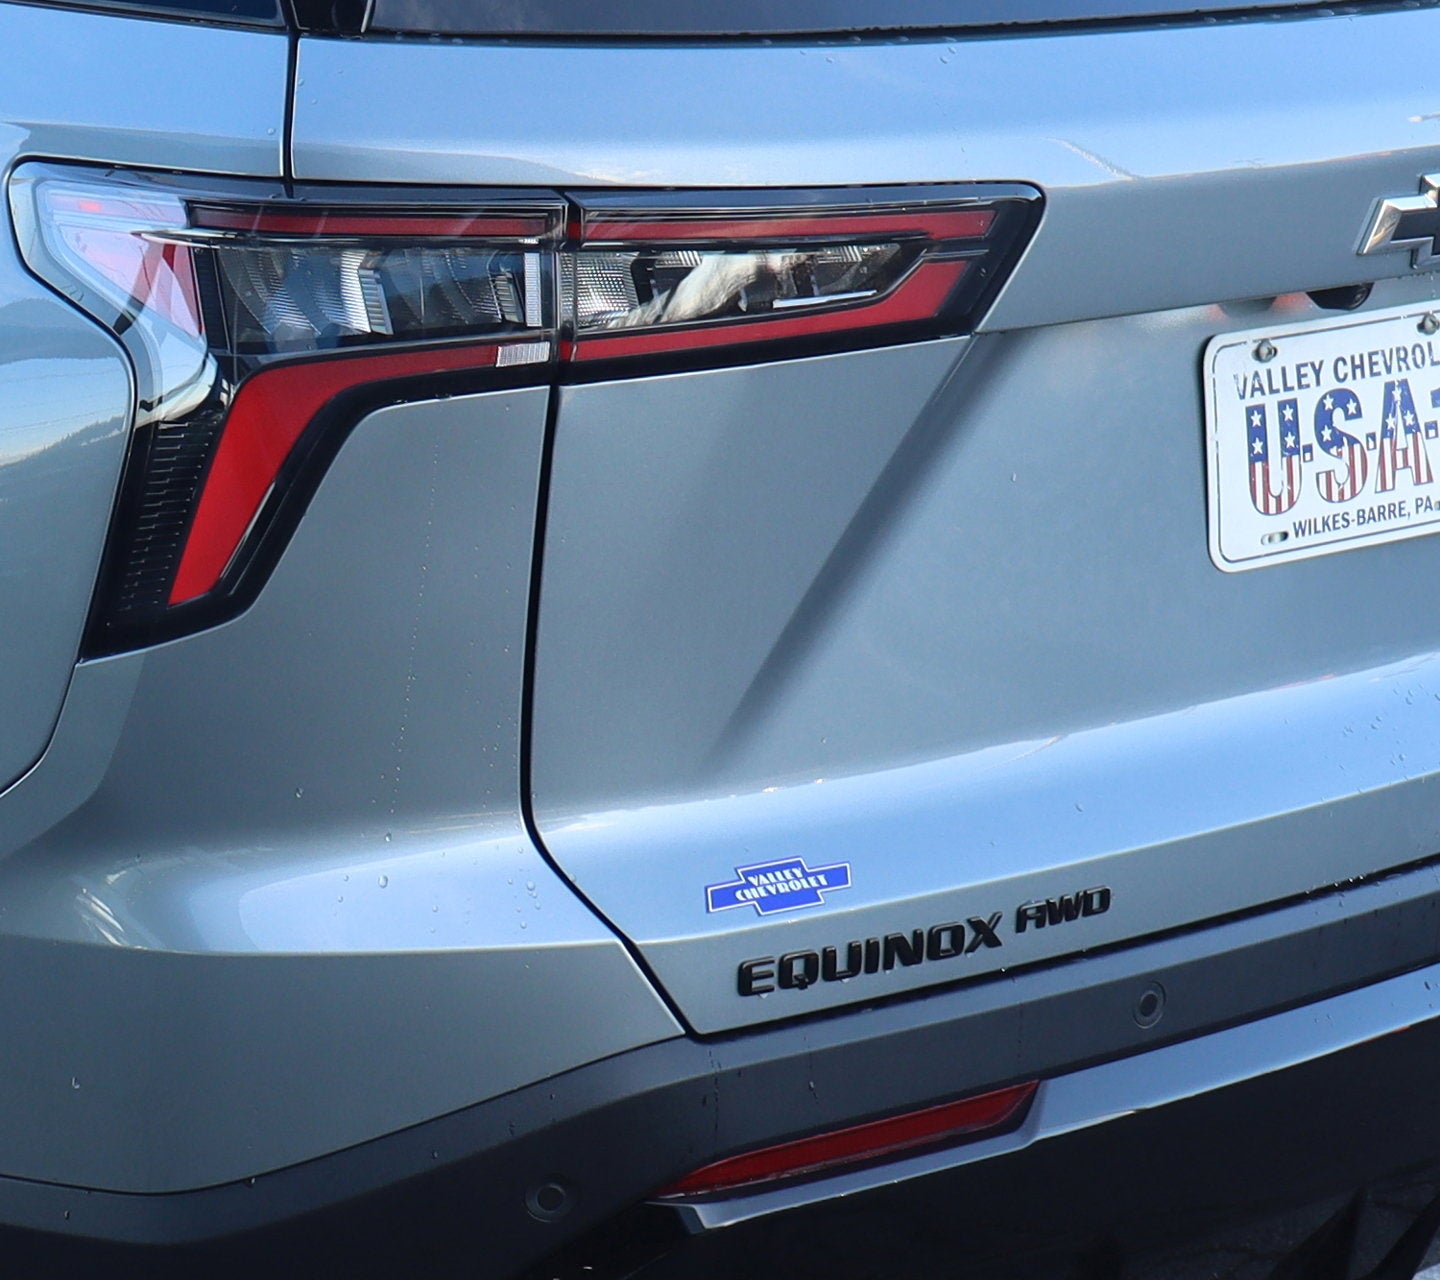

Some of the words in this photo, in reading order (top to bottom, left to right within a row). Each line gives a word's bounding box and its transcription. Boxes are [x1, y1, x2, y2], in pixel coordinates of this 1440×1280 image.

[1232, 360, 1325, 401] VALLEY
[1292, 501, 1412, 539] WILKES-BARRE,
[1415, 495, 1434, 514] PA
[735, 874, 829, 902] CHEVROLET
[747, 867, 804, 887] VALLEY
[737, 911, 1003, 997] EQUINOX
[1015, 885, 1112, 933] AWD
